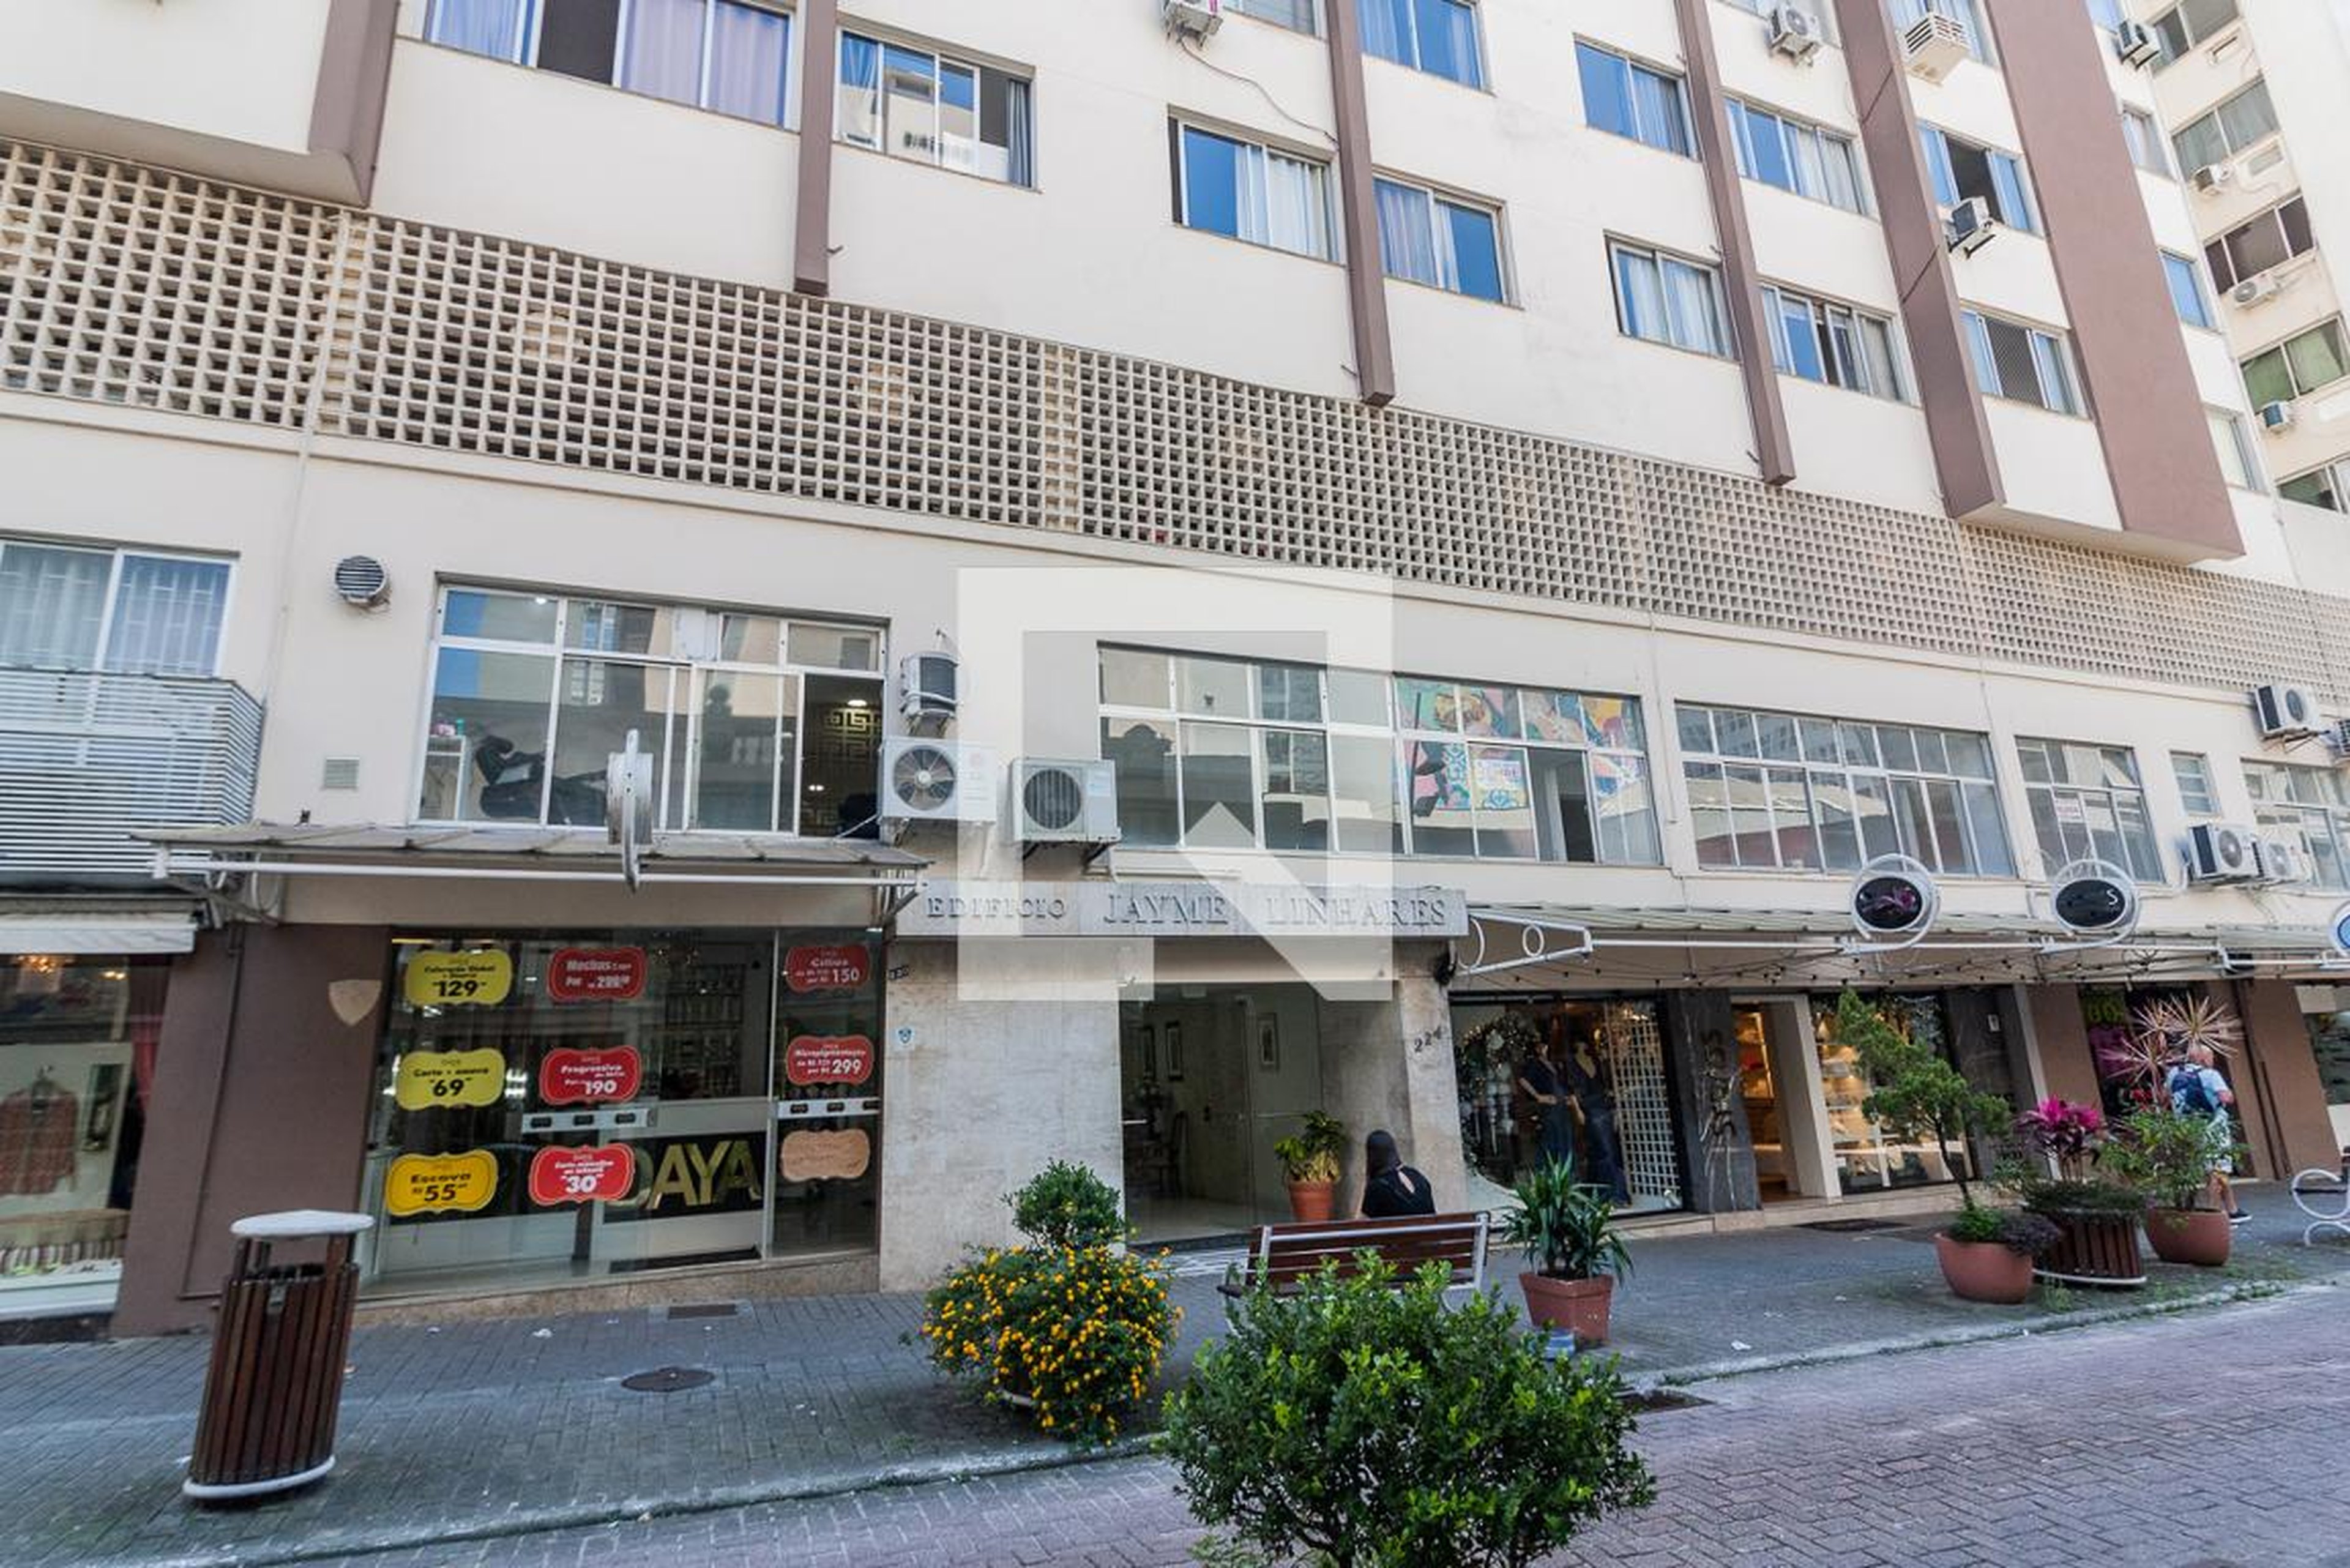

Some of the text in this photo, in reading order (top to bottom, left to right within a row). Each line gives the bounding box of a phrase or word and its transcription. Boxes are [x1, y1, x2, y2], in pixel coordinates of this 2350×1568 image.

[1103, 894, 1228, 925] JAYME
[1266, 897, 1446, 926] LINHARES
[832, 966, 860, 984] 150
[439, 980, 479, 998] 129
[832, 1059, 862, 1075] 299
[433, 1078, 464, 1097] 69
[585, 1079, 618, 1096] 190
[410, 1172, 471, 1184] Escova
[565, 1174, 597, 1194] 30
[423, 1184, 457, 1202] 55
